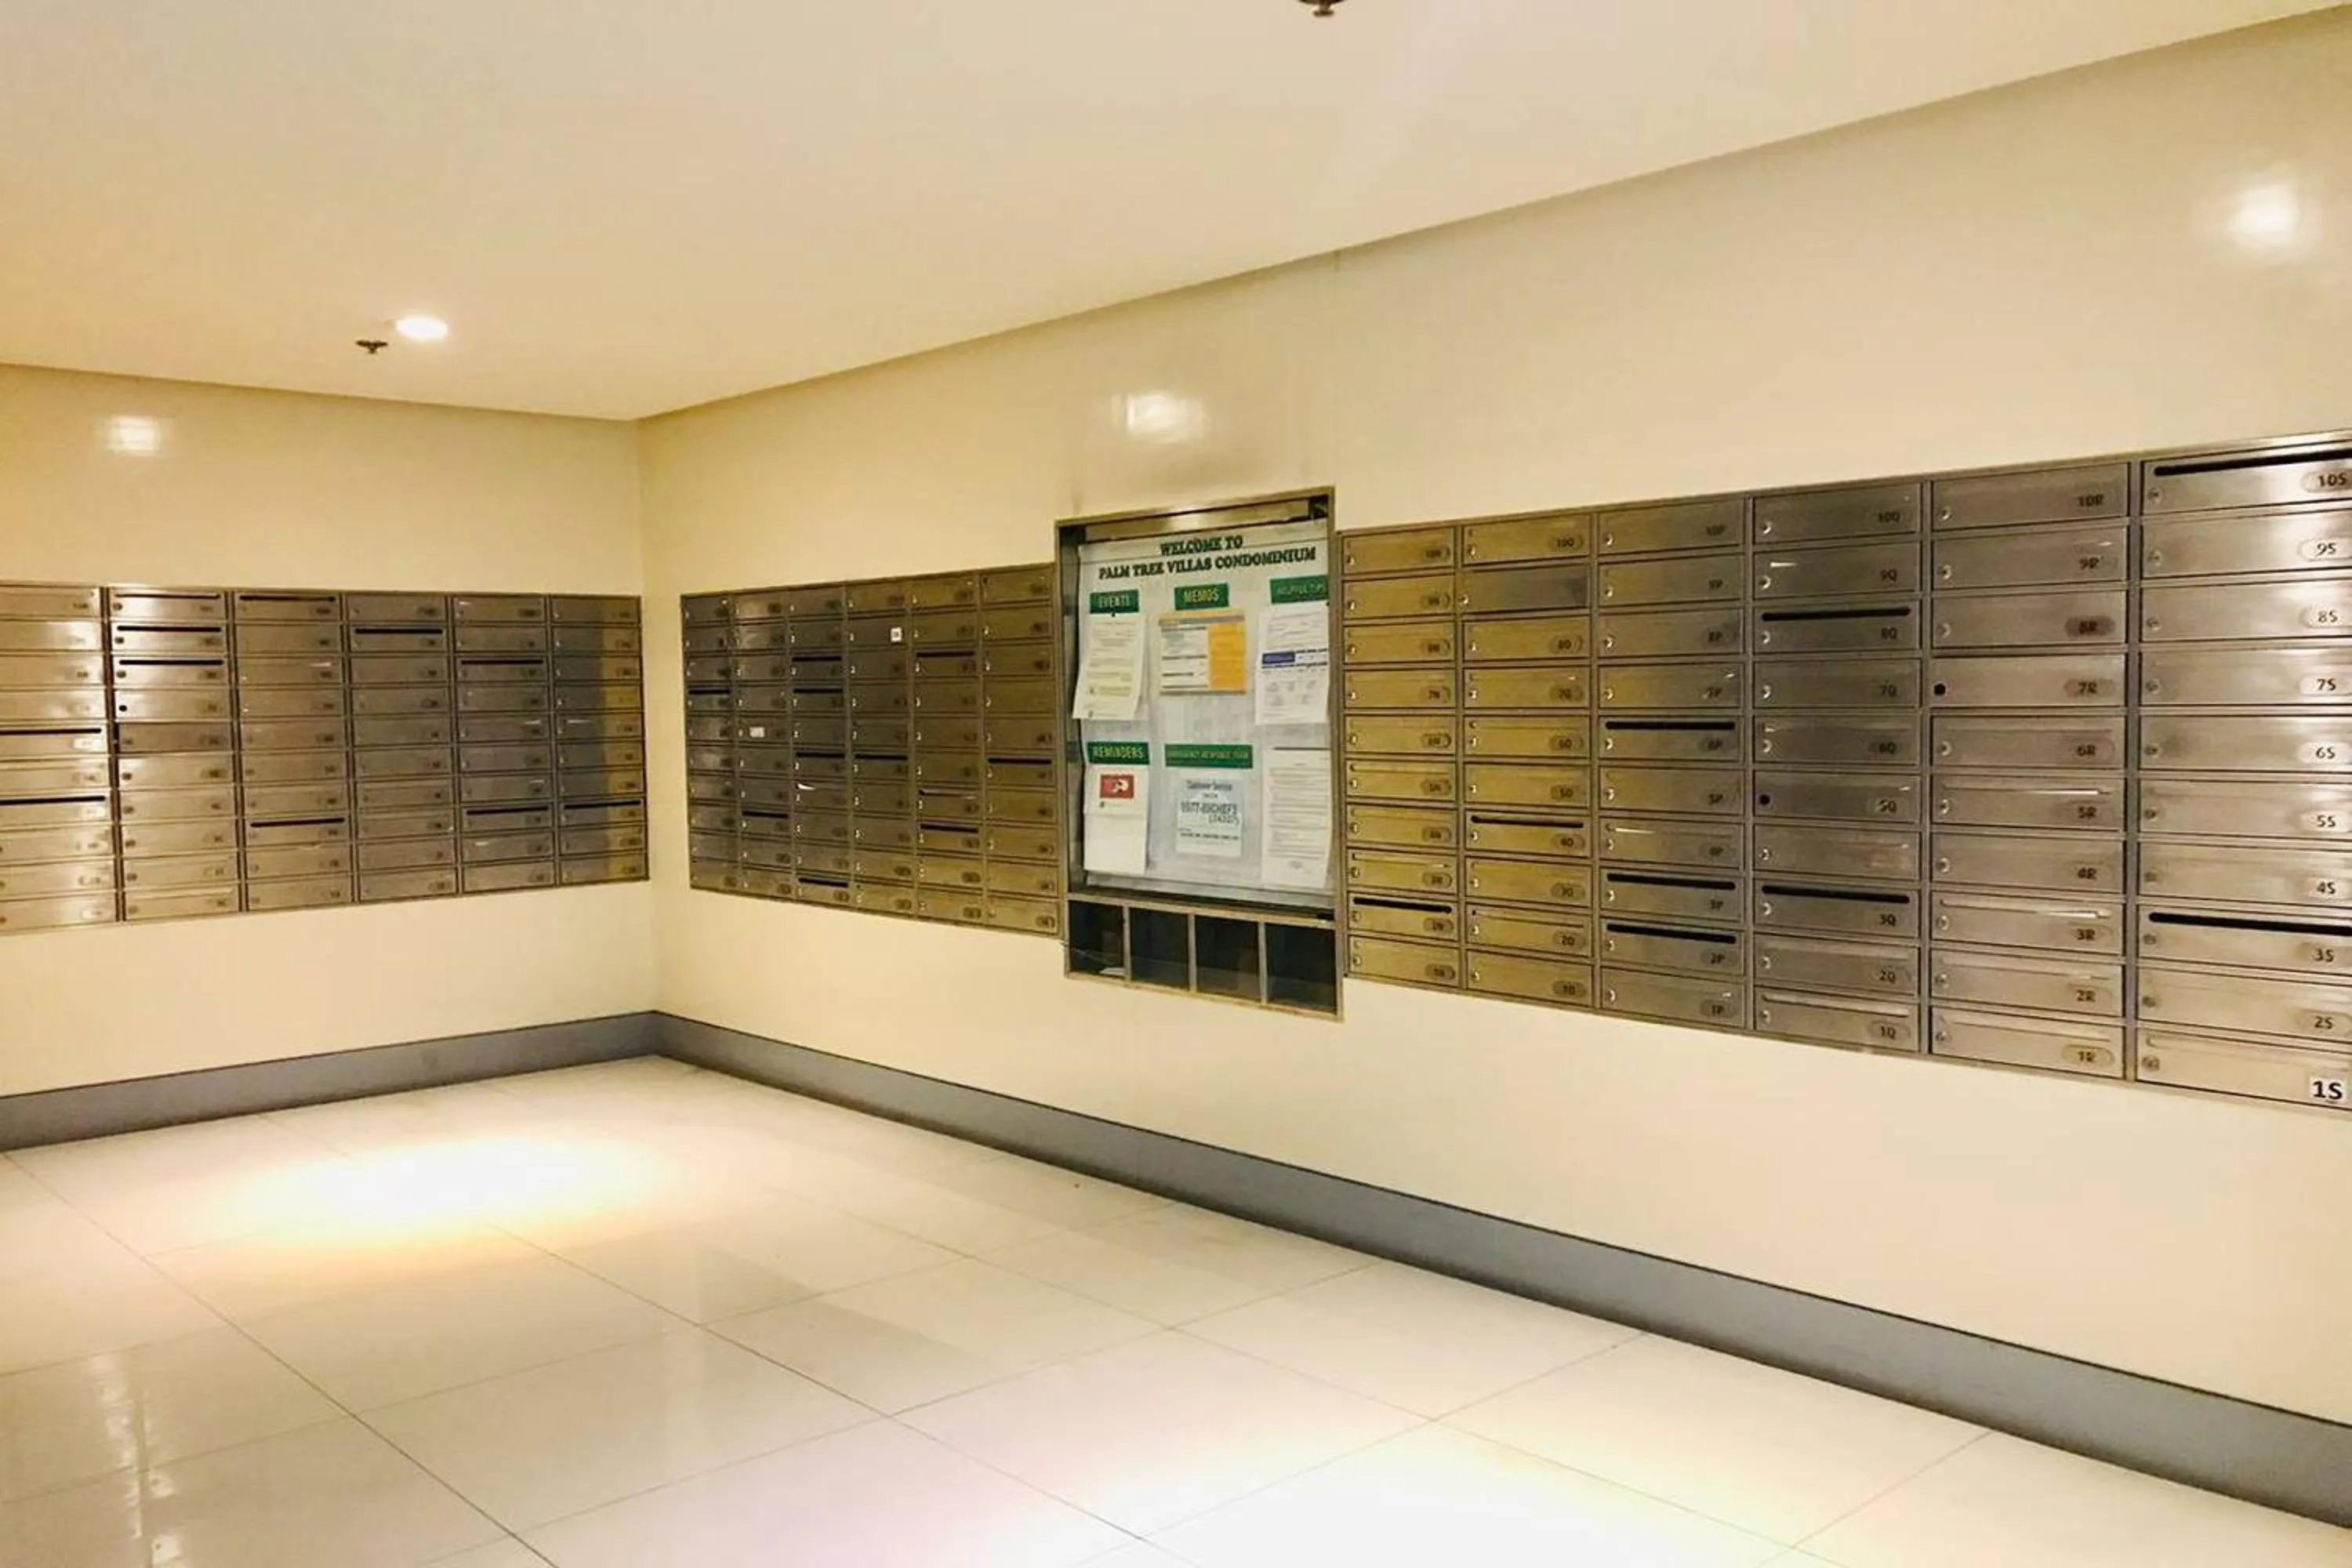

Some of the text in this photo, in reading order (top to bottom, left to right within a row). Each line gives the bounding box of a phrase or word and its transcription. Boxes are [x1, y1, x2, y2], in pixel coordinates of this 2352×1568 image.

[2318, 474, 2347, 486] 10S
[2078, 494, 2104, 507] 10R
[1878, 512, 1900, 522] 10Q
[1160, 535, 1243, 556] WELCOME TO
[2317, 543, 2336, 555] 9S
[1099, 546, 1316, 579] PALM TREE VILLAS CONDOMINIUM
[2079, 557, 2100, 570] 9R
[1880, 569, 1897, 581] 9Q
[1183, 587, 1220, 603] MEMOS
[2318, 611, 2338, 623] 8S
[1880, 684, 1897, 697] 7Q
[2078, 681, 2097, 694] 7R
[2317, 679, 2336, 691] 7S
[1093, 746, 1143, 759] REMINDERS
[2077, 744, 2096, 756] 6R
[2316, 746, 2336, 759] 6S
[2078, 807, 2096, 818] 5R
[2317, 815, 2336, 827] 5S
[2316, 882, 2336, 894] 4S
[1880, 914, 1896, 926] 3Q
[2077, 928, 2096, 941] 3R
[2314, 949, 2334, 962] 3S
[1879, 970, 1895, 983] 2Q
[2076, 989, 2096, 1002] 2R
[2314, 1016, 2333, 1029] 2S
[1881, 1026, 1896, 1040] 1Q
[2078, 1051, 2095, 1062] 1R
[2313, 1081, 2342, 1099] 1S
